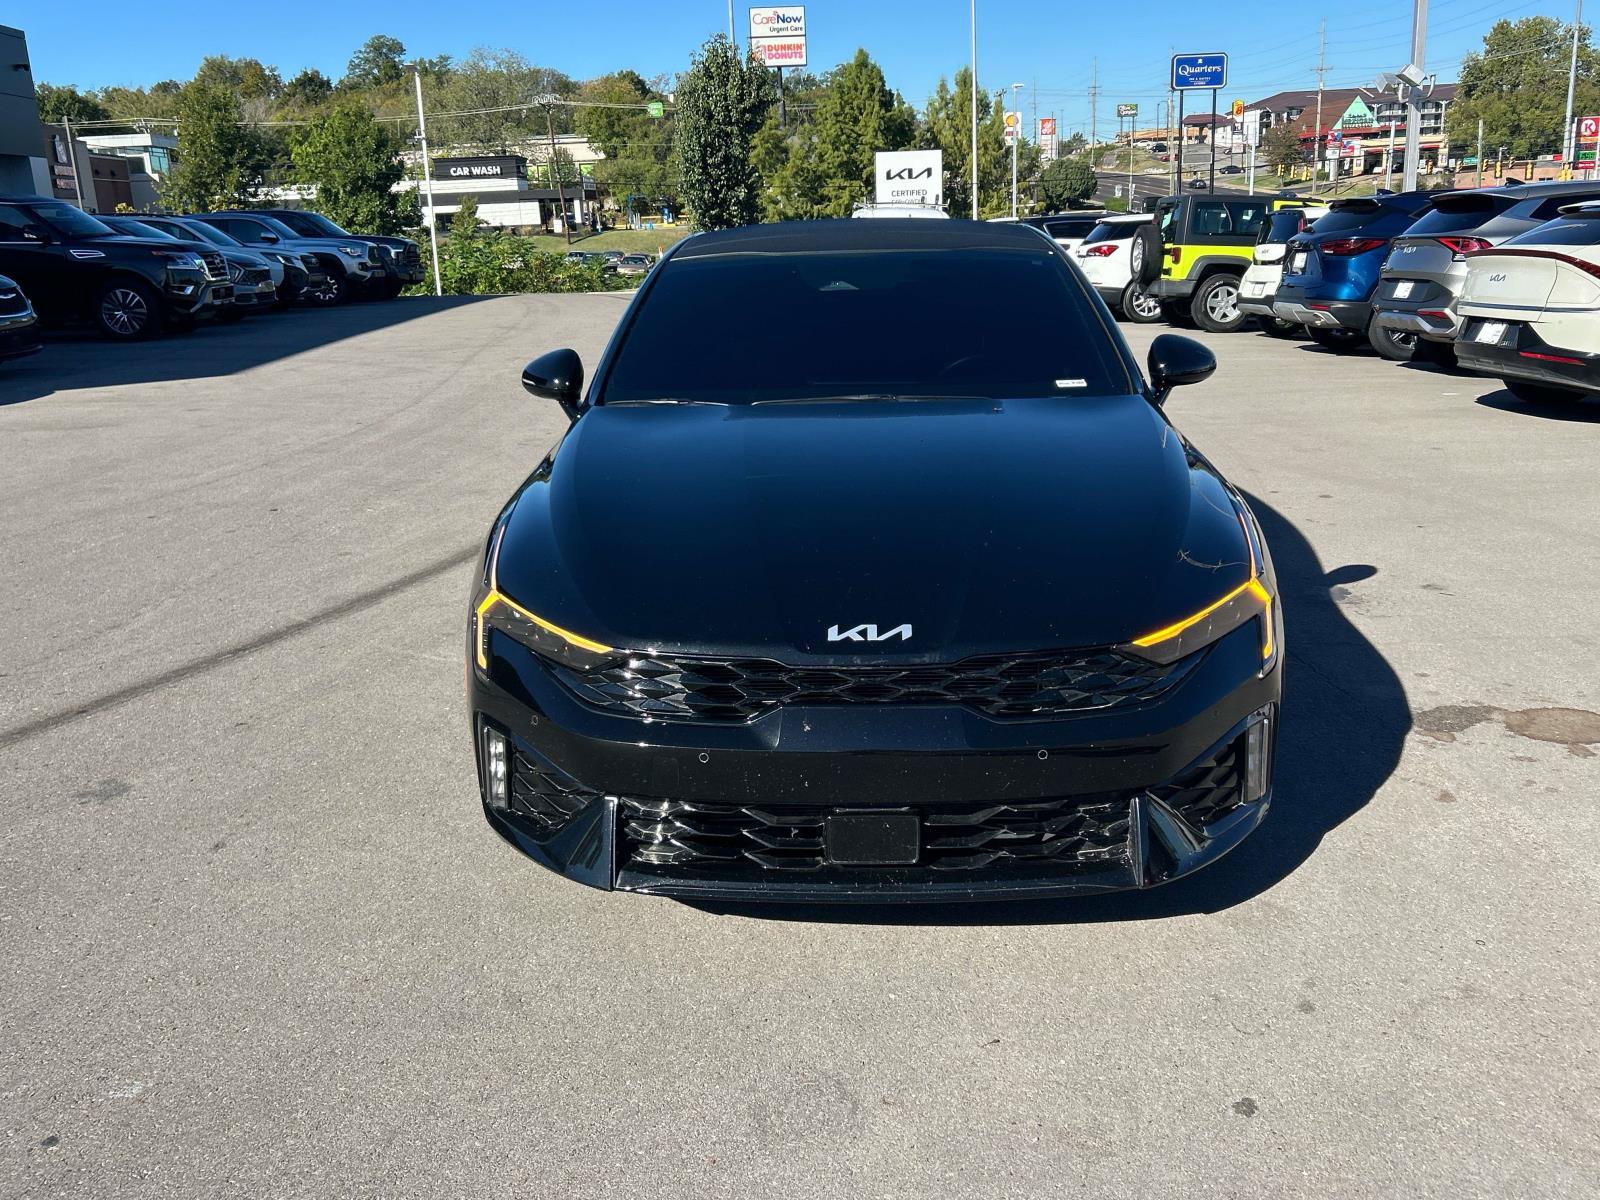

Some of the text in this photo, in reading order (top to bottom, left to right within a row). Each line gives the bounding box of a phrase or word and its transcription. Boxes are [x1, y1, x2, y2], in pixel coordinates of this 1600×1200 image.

[753, 13, 802, 25] CareNow
[1178, 64, 1222, 76] Quarters
[1584, 122, 1593, 133] K
[450, 165, 501, 176] CAR WASH
[886, 167, 932, 180] KIA
[891, 188, 928, 197] CERTIFIED
[827, 623, 913, 641] KIA
